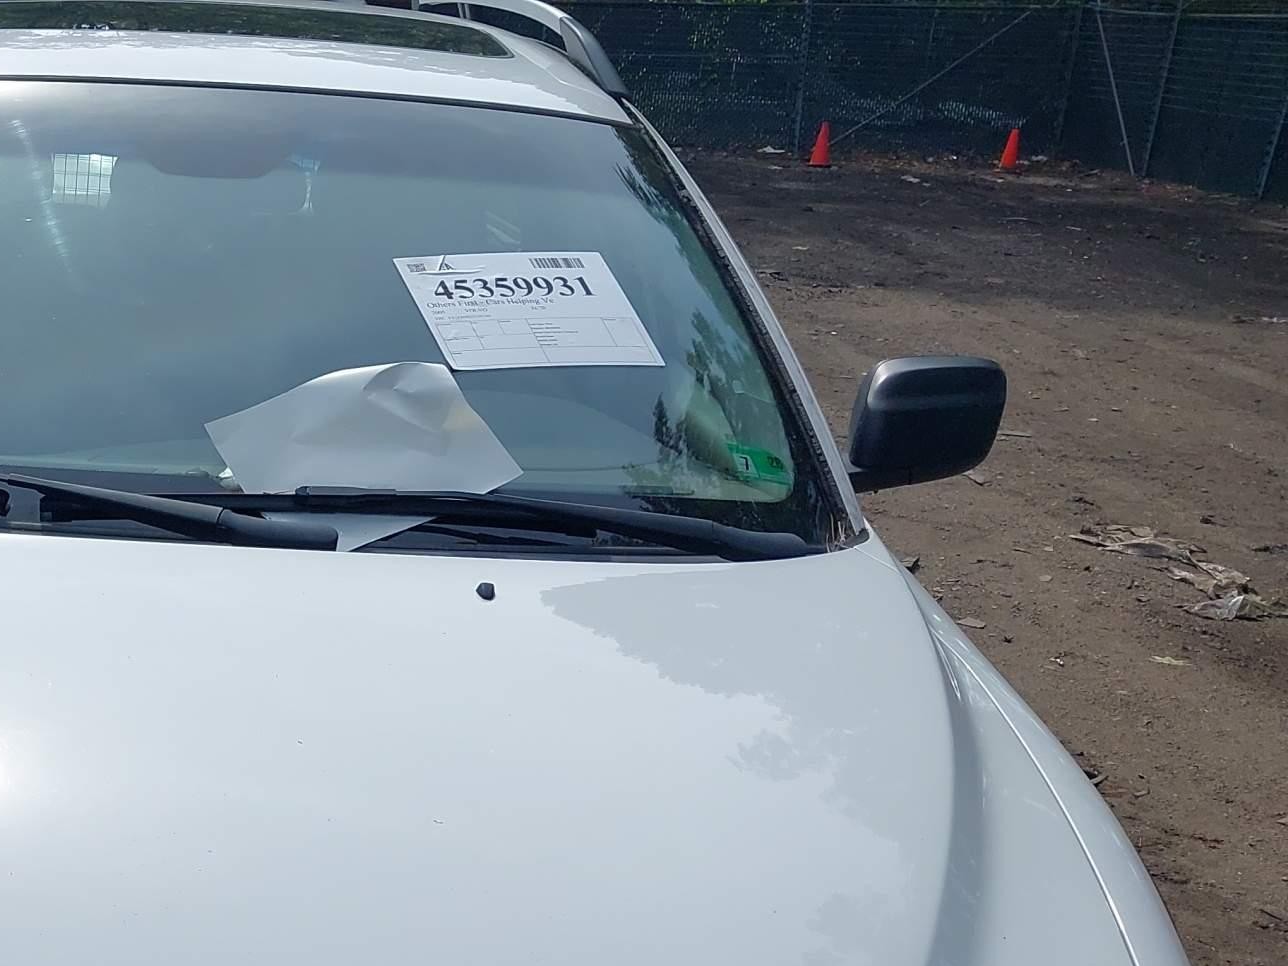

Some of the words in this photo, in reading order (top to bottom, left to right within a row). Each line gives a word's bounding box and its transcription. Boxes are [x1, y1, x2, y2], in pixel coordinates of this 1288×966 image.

[434, 275, 597, 299] 45359931
[426, 301, 456, 309] Others
[485, 298, 506, 306] Cars
[507, 297, 540, 306] Helping
[739, 455, 750, 471] 7
